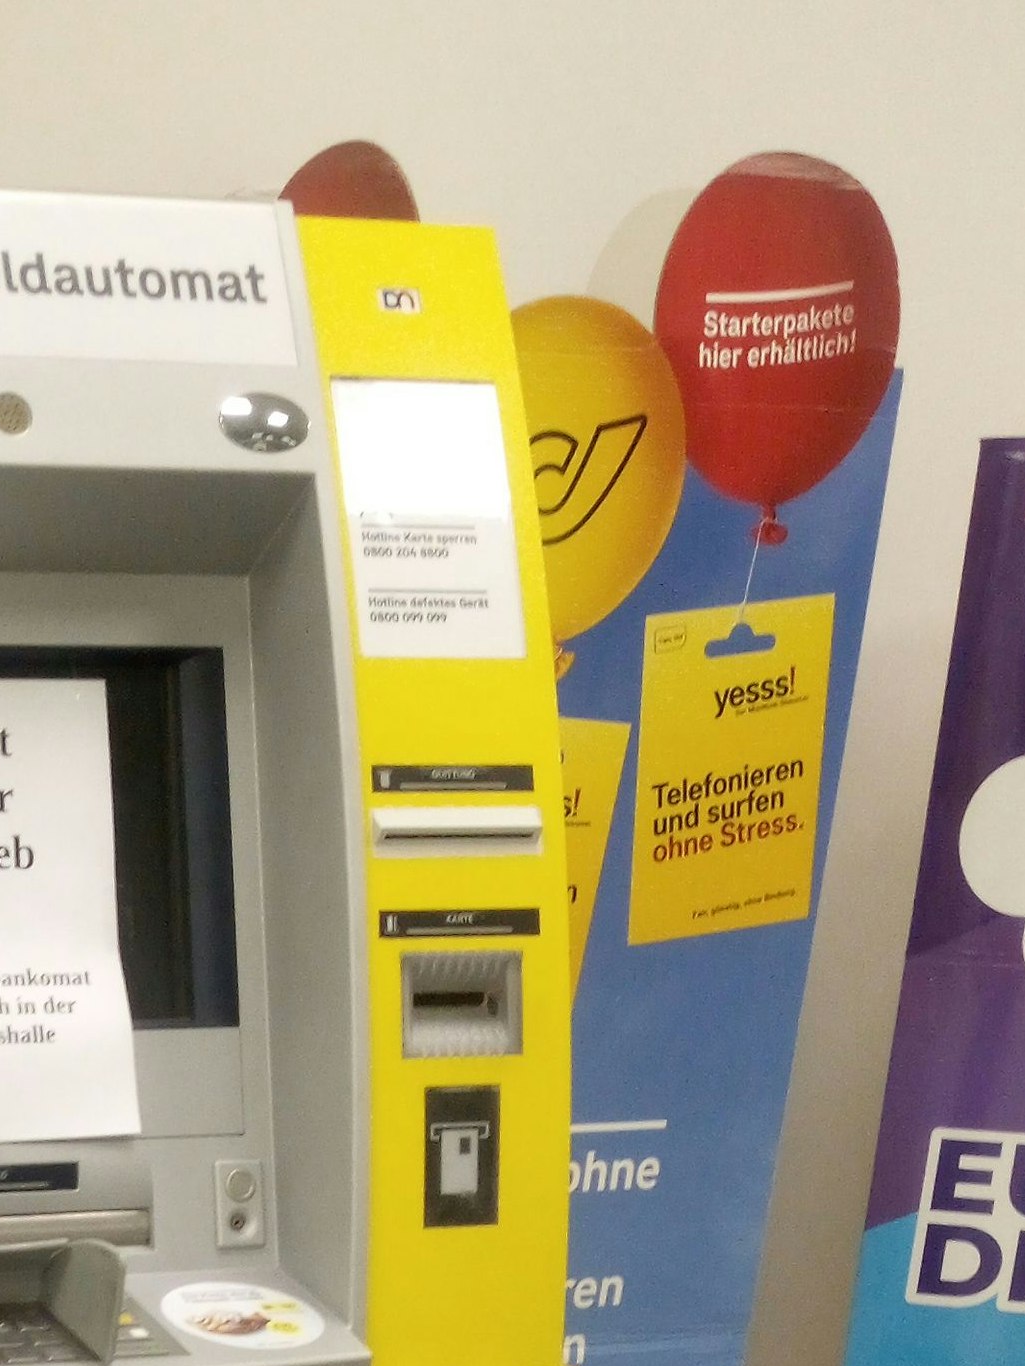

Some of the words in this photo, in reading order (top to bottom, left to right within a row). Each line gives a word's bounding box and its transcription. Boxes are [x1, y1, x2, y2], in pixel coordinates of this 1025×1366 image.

[703, 303, 855, 338] Starterpakete
[699, 342, 742, 368] hier
[747, 329, 857, 367] erhältlich!
[361, 531, 400, 543] Hotline
[368, 596, 407, 608] Hotline
[410, 597, 456, 608] defektes
[370, 611, 399, 622] 0800
[714, 667, 795, 719] yesss!
[652, 759, 804, 809] Telefonieren
[653, 804, 700, 836] und
[707, 789, 785, 824] surfen
[652, 832, 713, 863] ohne
[720, 812, 805, 849] Stress.
[16, 997, 36, 1015] in
[44, 996, 77, 1015] der
